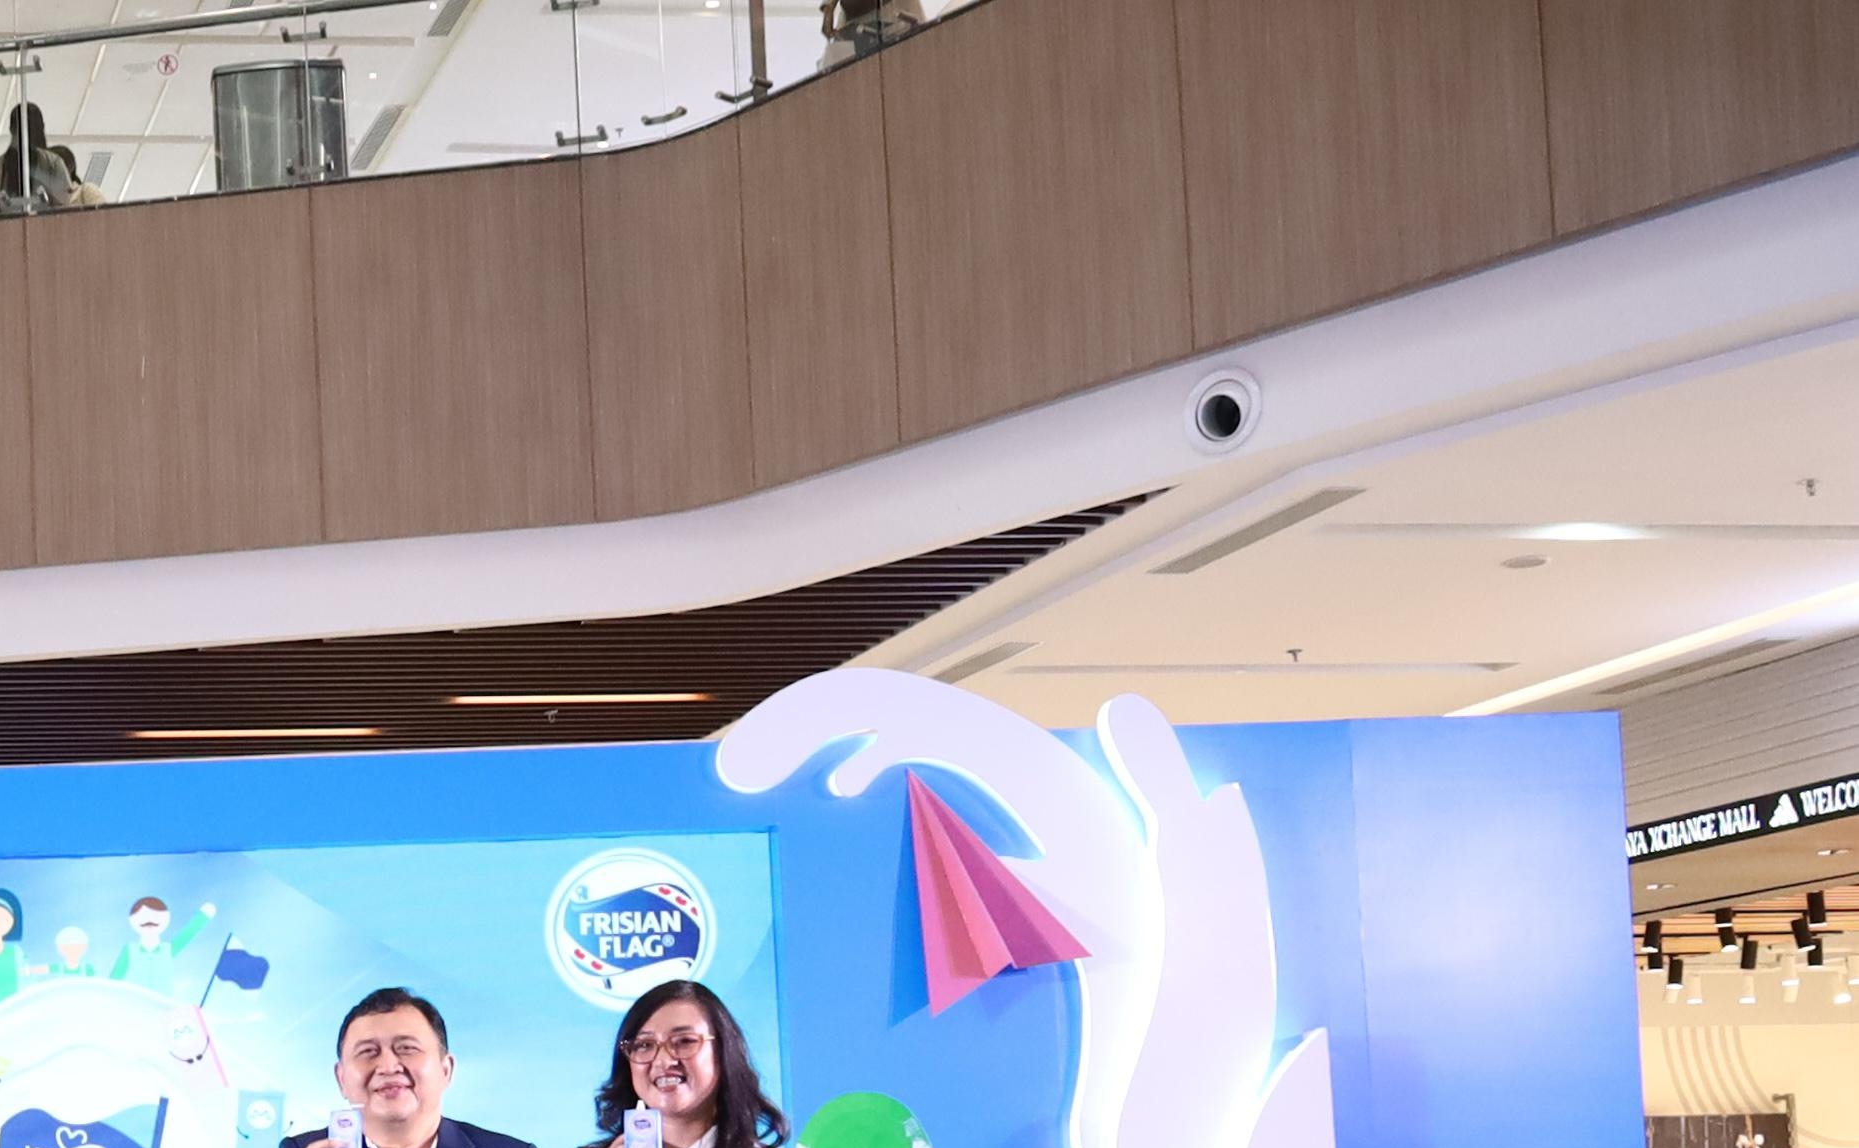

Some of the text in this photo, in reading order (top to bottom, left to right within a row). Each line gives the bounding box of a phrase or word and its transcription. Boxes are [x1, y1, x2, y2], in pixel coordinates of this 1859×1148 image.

[1799, 779, 1859, 817] WELCO
[1648, 813, 1718, 852] XCHANGE
[1718, 804, 1761, 837] MALL
[579, 910, 681, 936] FRISIAN
